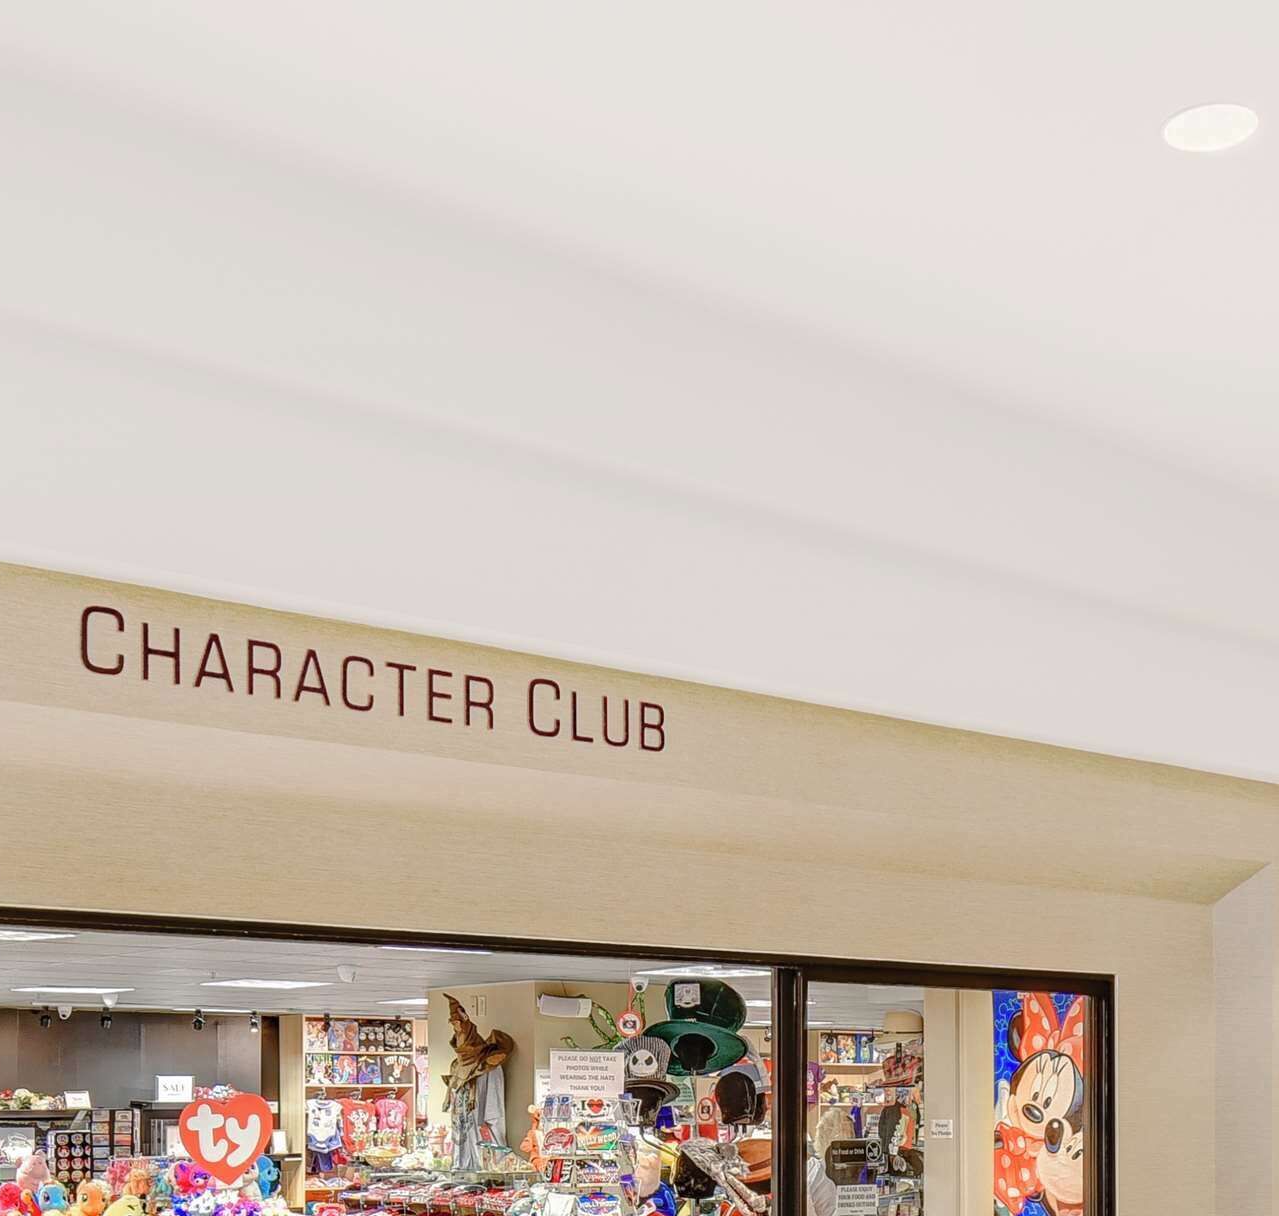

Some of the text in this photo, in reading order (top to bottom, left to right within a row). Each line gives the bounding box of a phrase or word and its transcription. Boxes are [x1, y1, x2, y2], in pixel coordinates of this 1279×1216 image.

[80, 605, 666, 753] CHARACTER CLUB
[186, 1103, 261, 1168] ty
